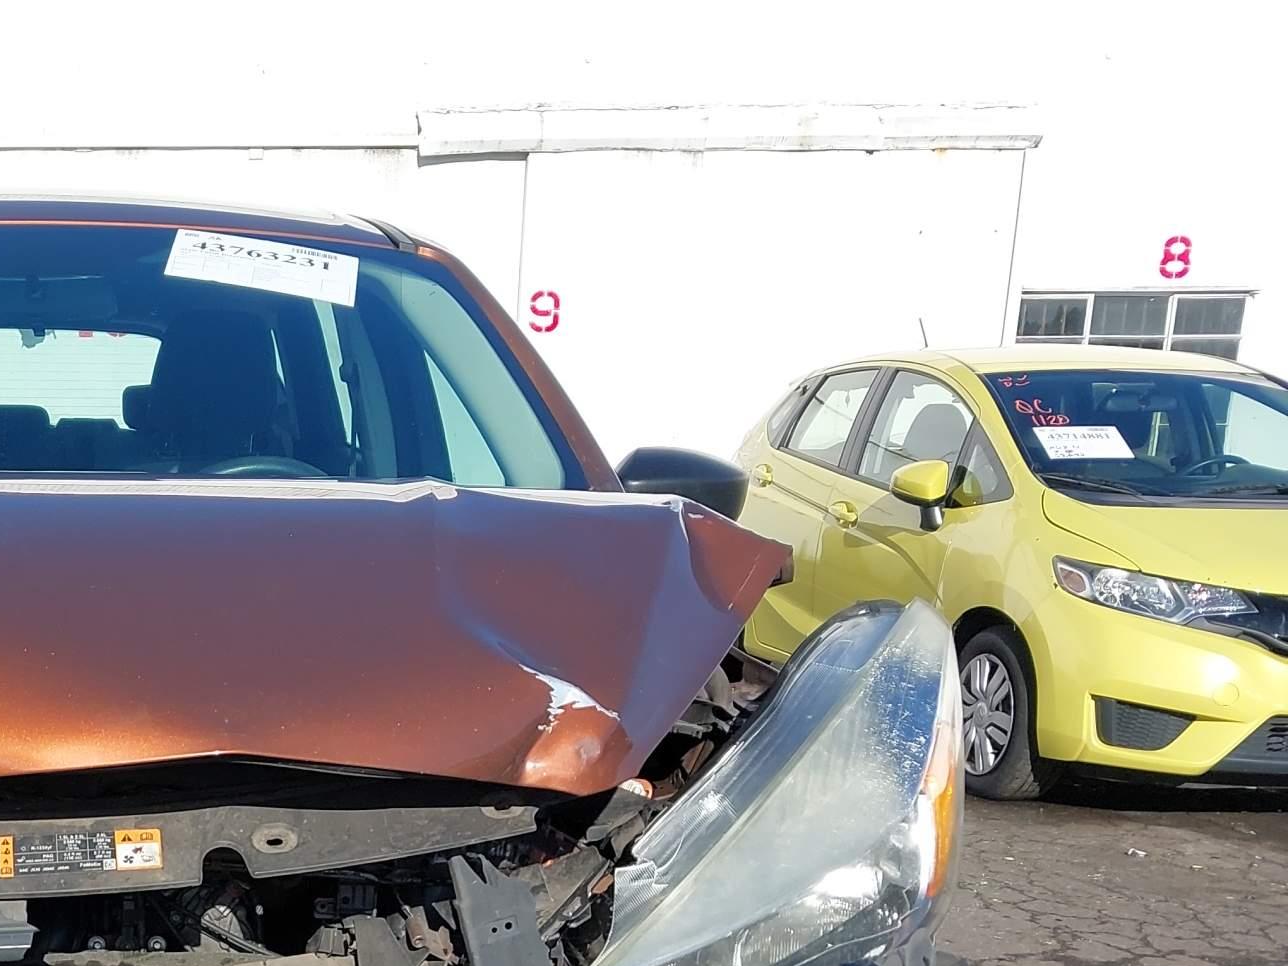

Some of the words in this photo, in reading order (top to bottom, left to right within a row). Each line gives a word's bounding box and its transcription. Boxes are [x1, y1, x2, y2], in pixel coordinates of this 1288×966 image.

[192, 241, 330, 271] 43763231
[1159, 235, 1192, 279] 8
[529, 290, 560, 333] 9
